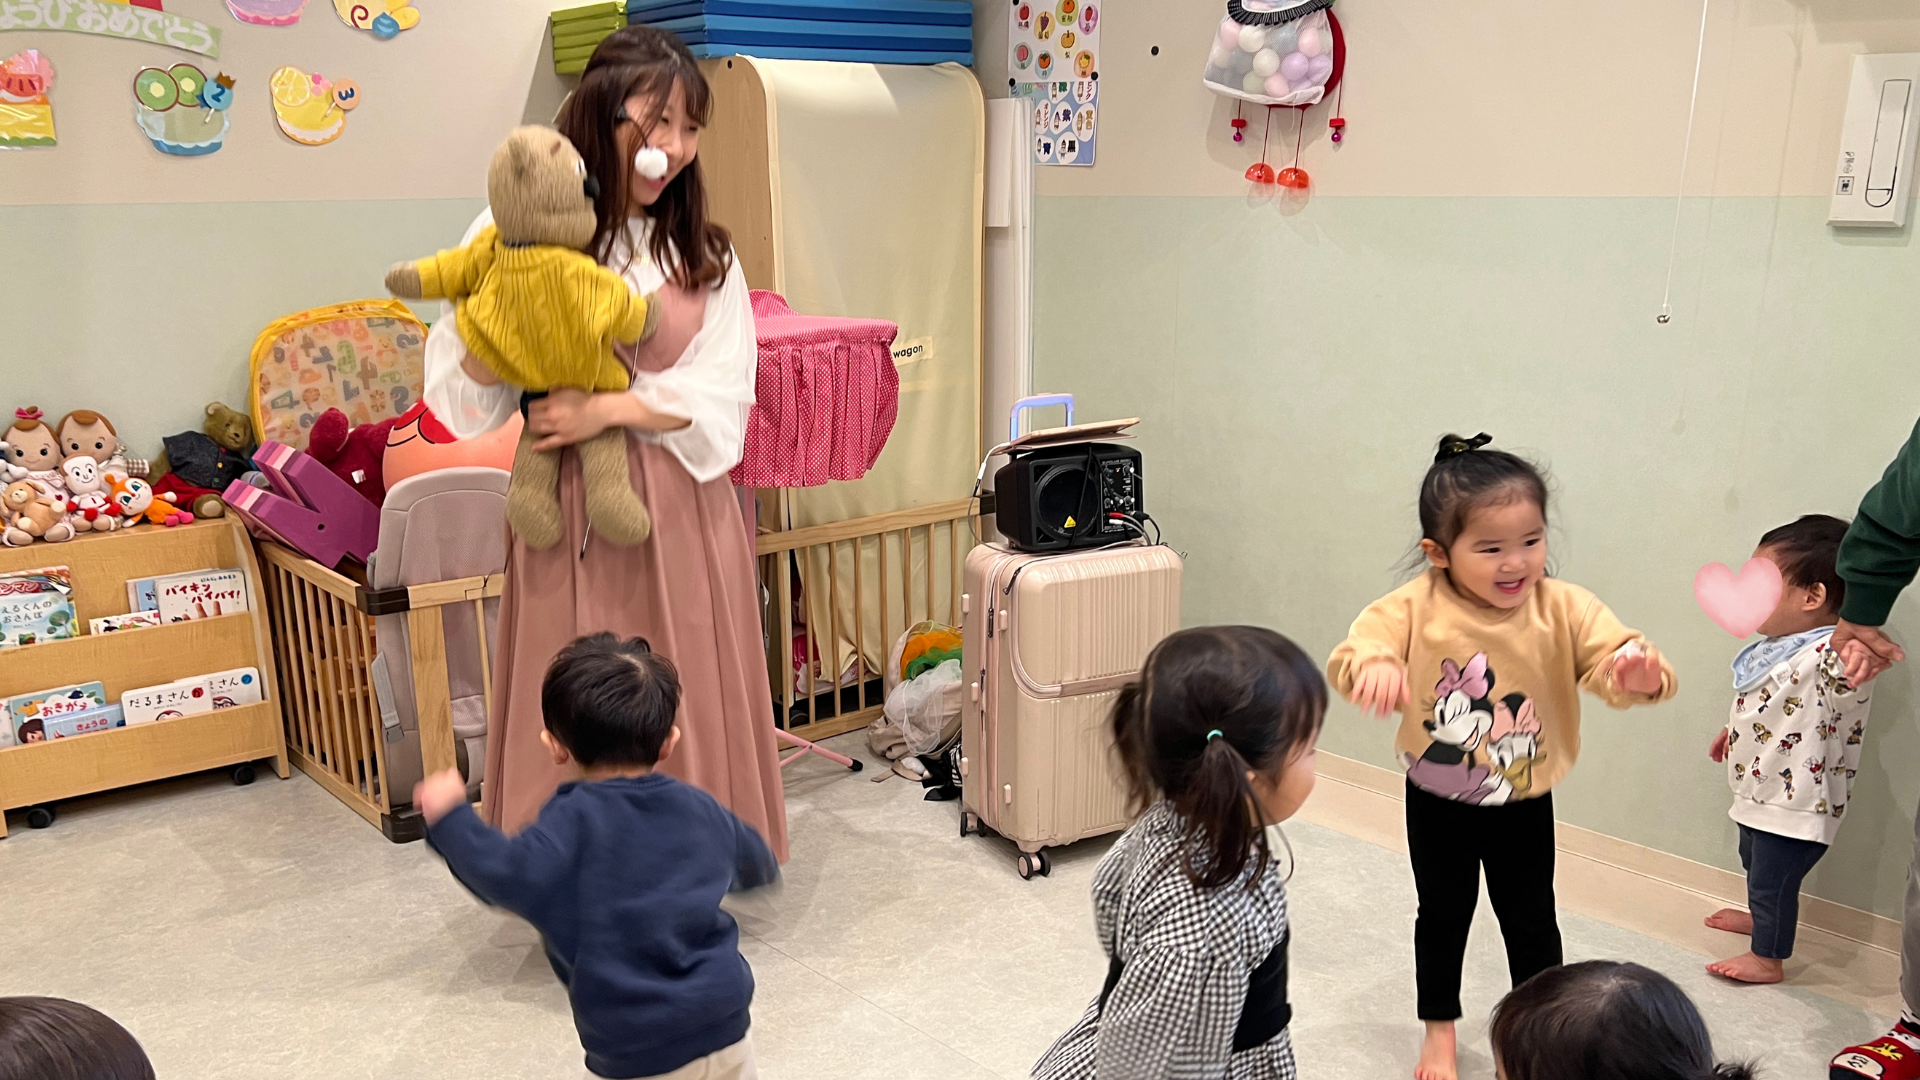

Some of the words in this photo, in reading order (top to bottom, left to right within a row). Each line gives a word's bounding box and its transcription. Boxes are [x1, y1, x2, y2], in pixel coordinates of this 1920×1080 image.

[211, 83, 226, 103] 2
[1067, 140, 1076, 152] 黒
[893, 345, 923, 359] wagon
[166, 582, 211, 596] バイキン
[76, 718, 108, 731] きょうの
